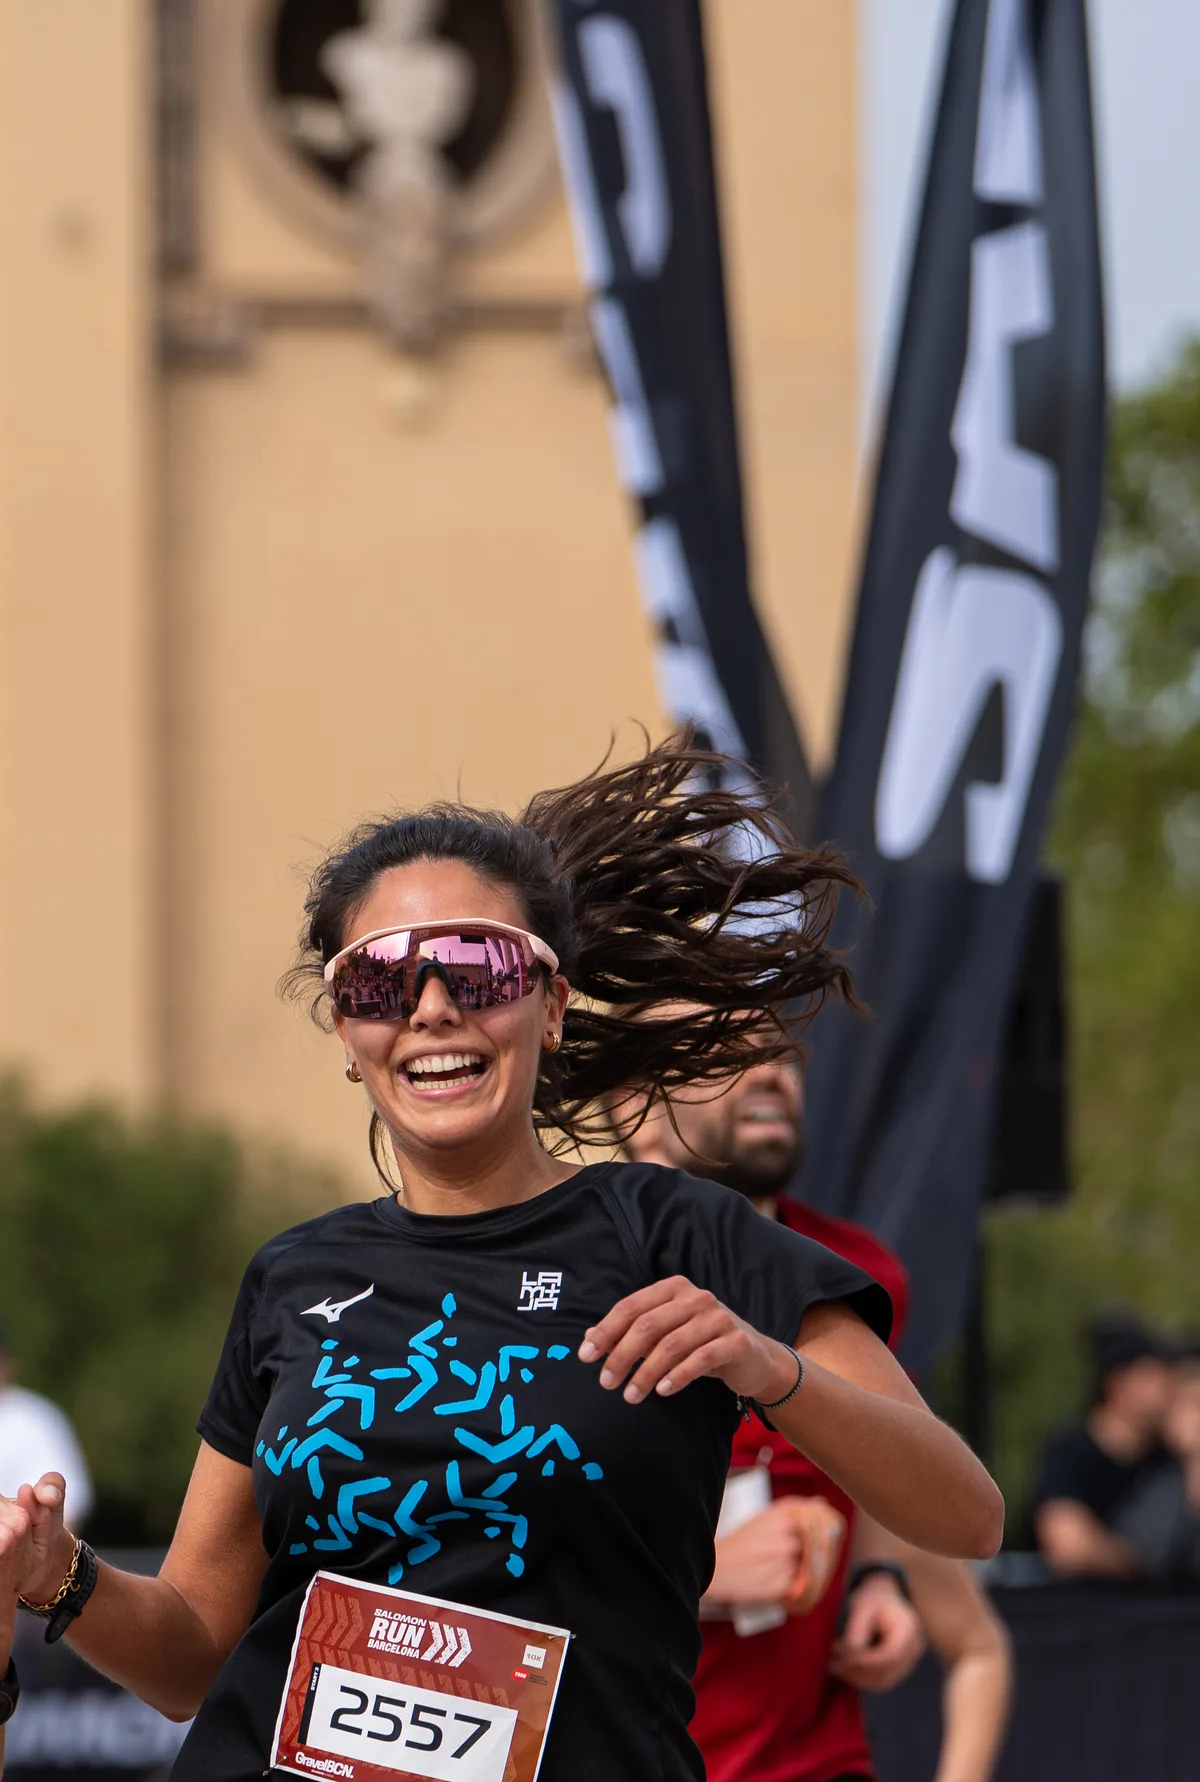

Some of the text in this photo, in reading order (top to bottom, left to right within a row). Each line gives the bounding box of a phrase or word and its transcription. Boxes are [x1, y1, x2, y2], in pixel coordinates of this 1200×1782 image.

[373, 1608, 428, 1627] SALOMON
[369, 1616, 426, 1649] RUN
[367, 1637, 420, 1659] BARCELONA
[526, 1653, 542, 1662] 10K
[329, 1684, 492, 1759] 2557
